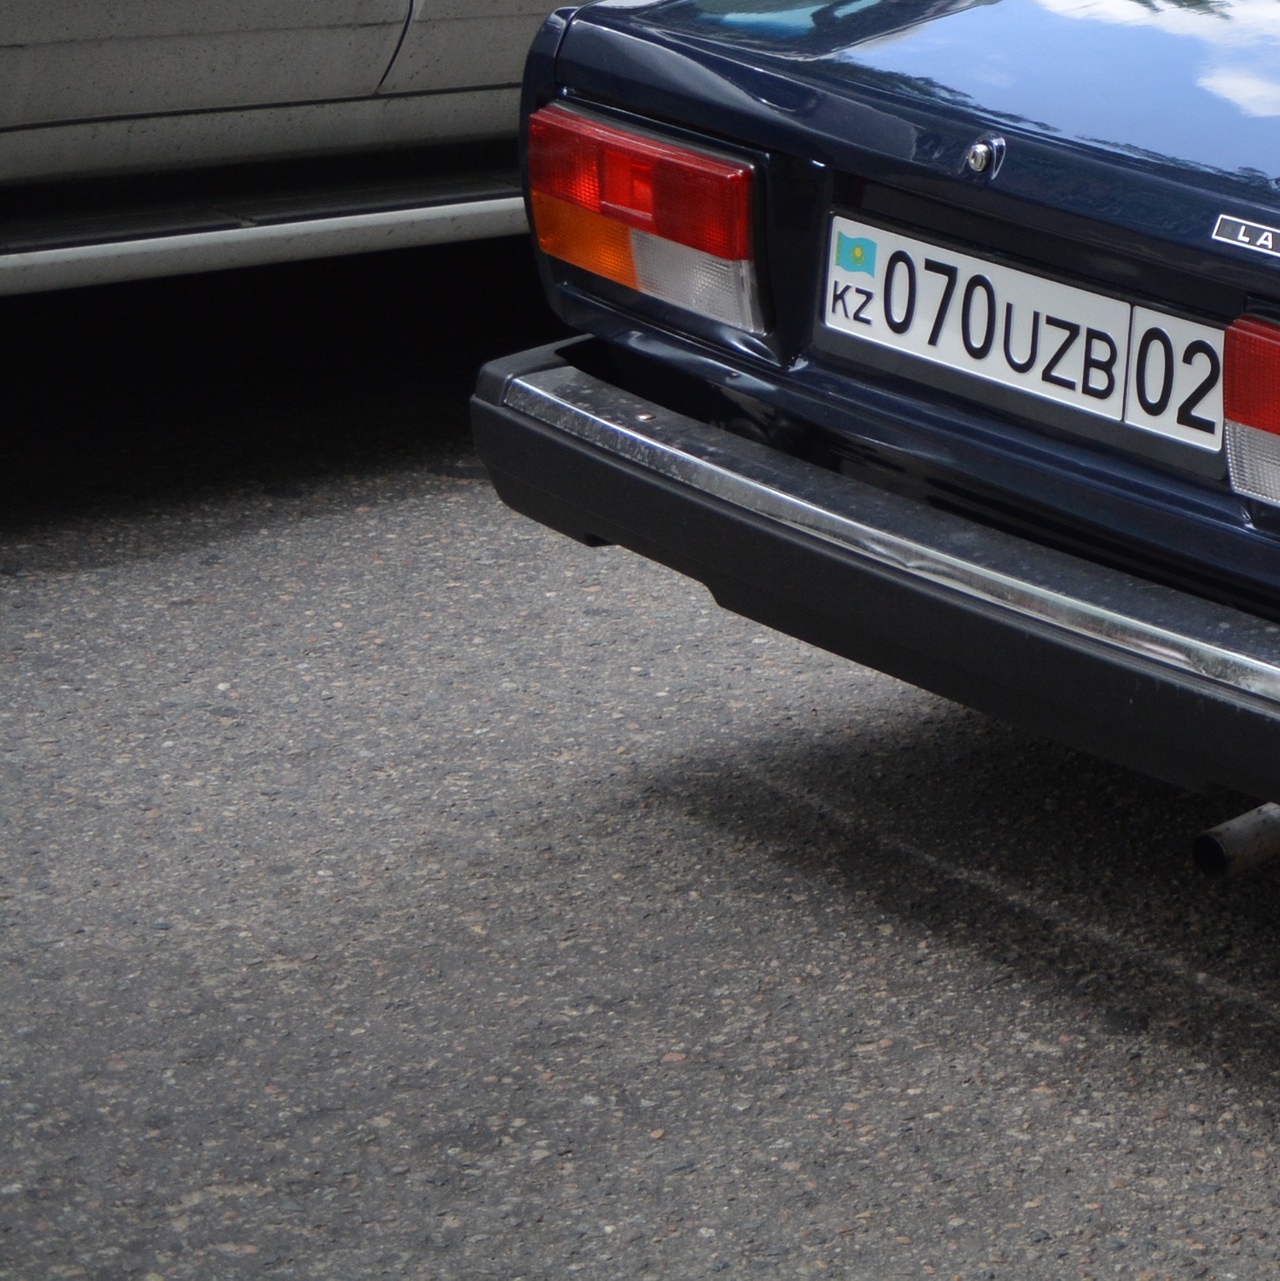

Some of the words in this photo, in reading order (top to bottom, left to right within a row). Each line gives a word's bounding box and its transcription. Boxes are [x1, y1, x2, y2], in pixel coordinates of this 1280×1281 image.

[831, 279, 875, 326] KZ
[883, 249, 1119, 400] 070UZB
[1135, 325, 1221, 436] 02
